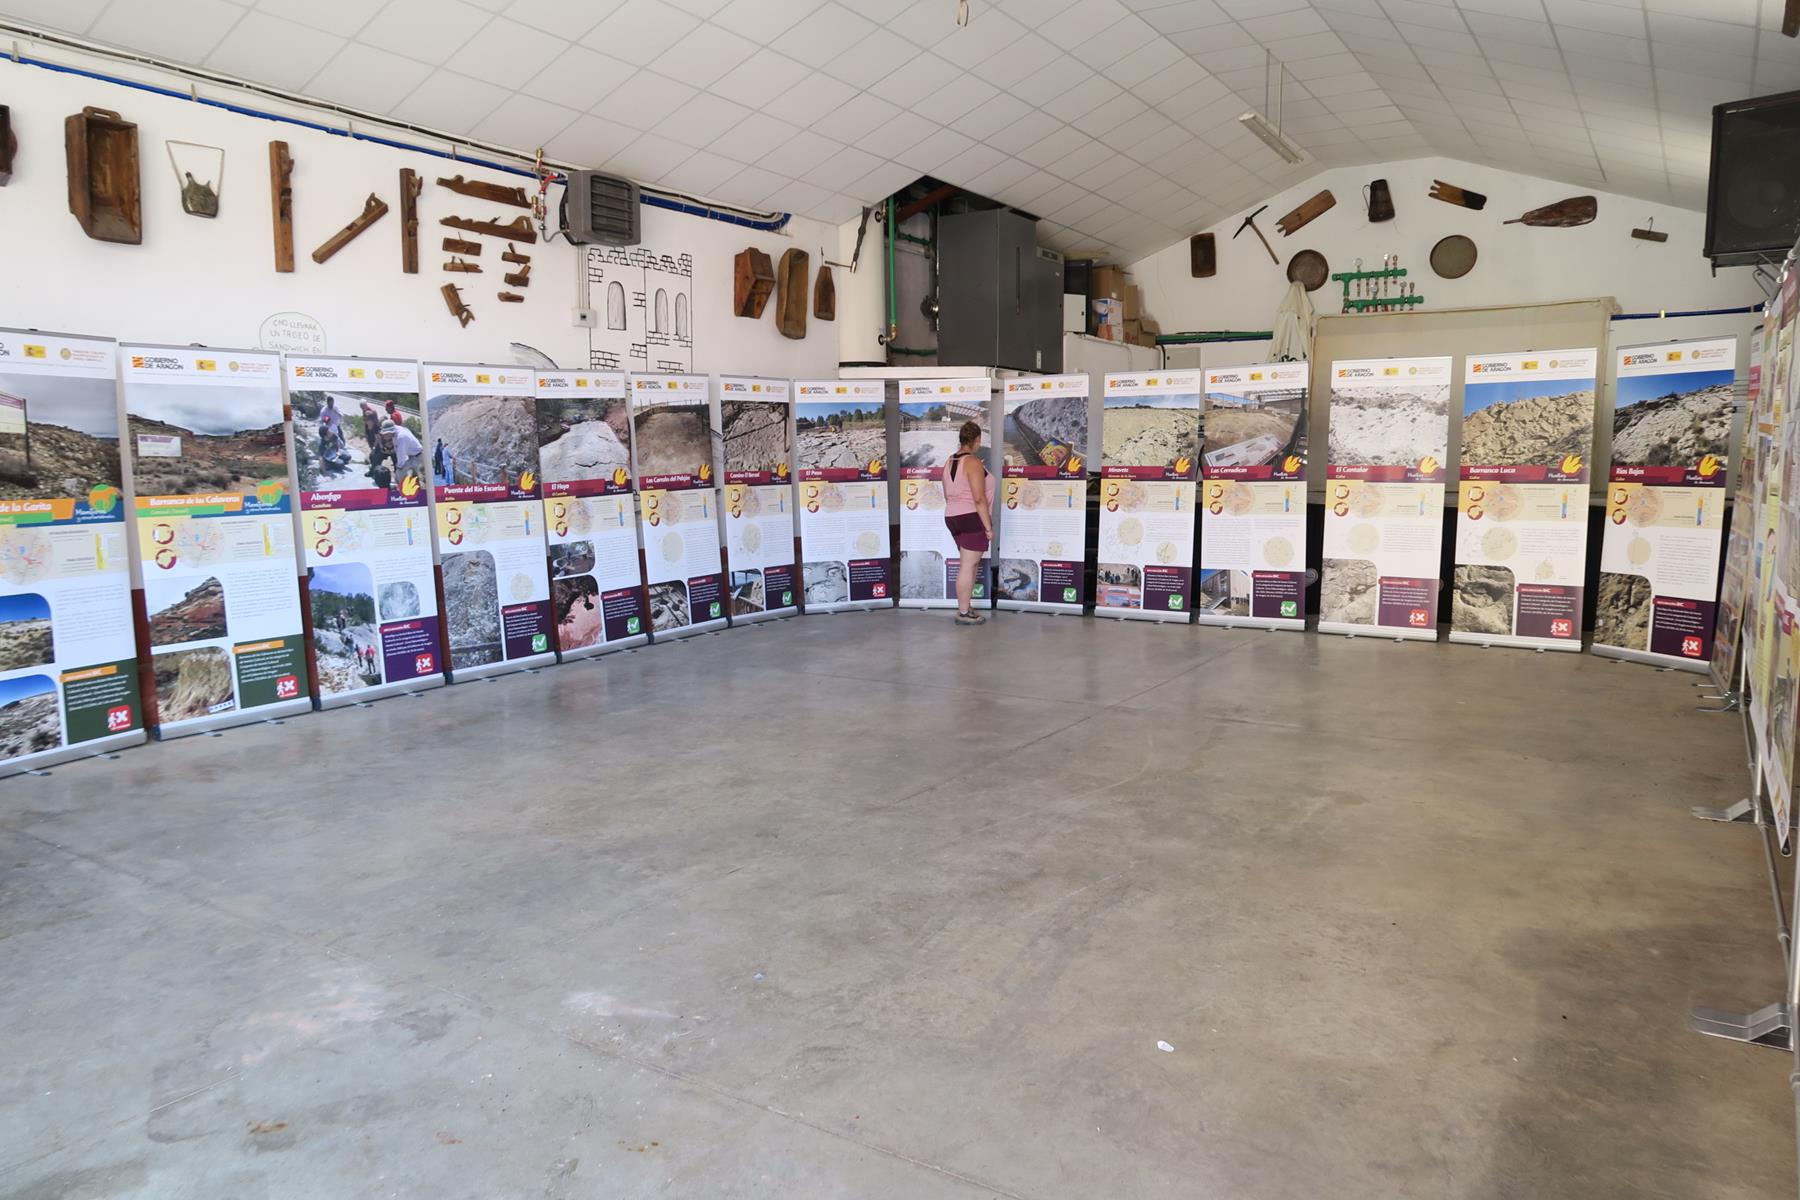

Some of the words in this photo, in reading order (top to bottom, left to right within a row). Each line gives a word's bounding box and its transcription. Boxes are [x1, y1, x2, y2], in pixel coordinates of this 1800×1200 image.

[150, 498, 184, 506] Barranco
[206, 496, 240, 504] Calaveras
[310, 492, 342, 502] Abenfigo
